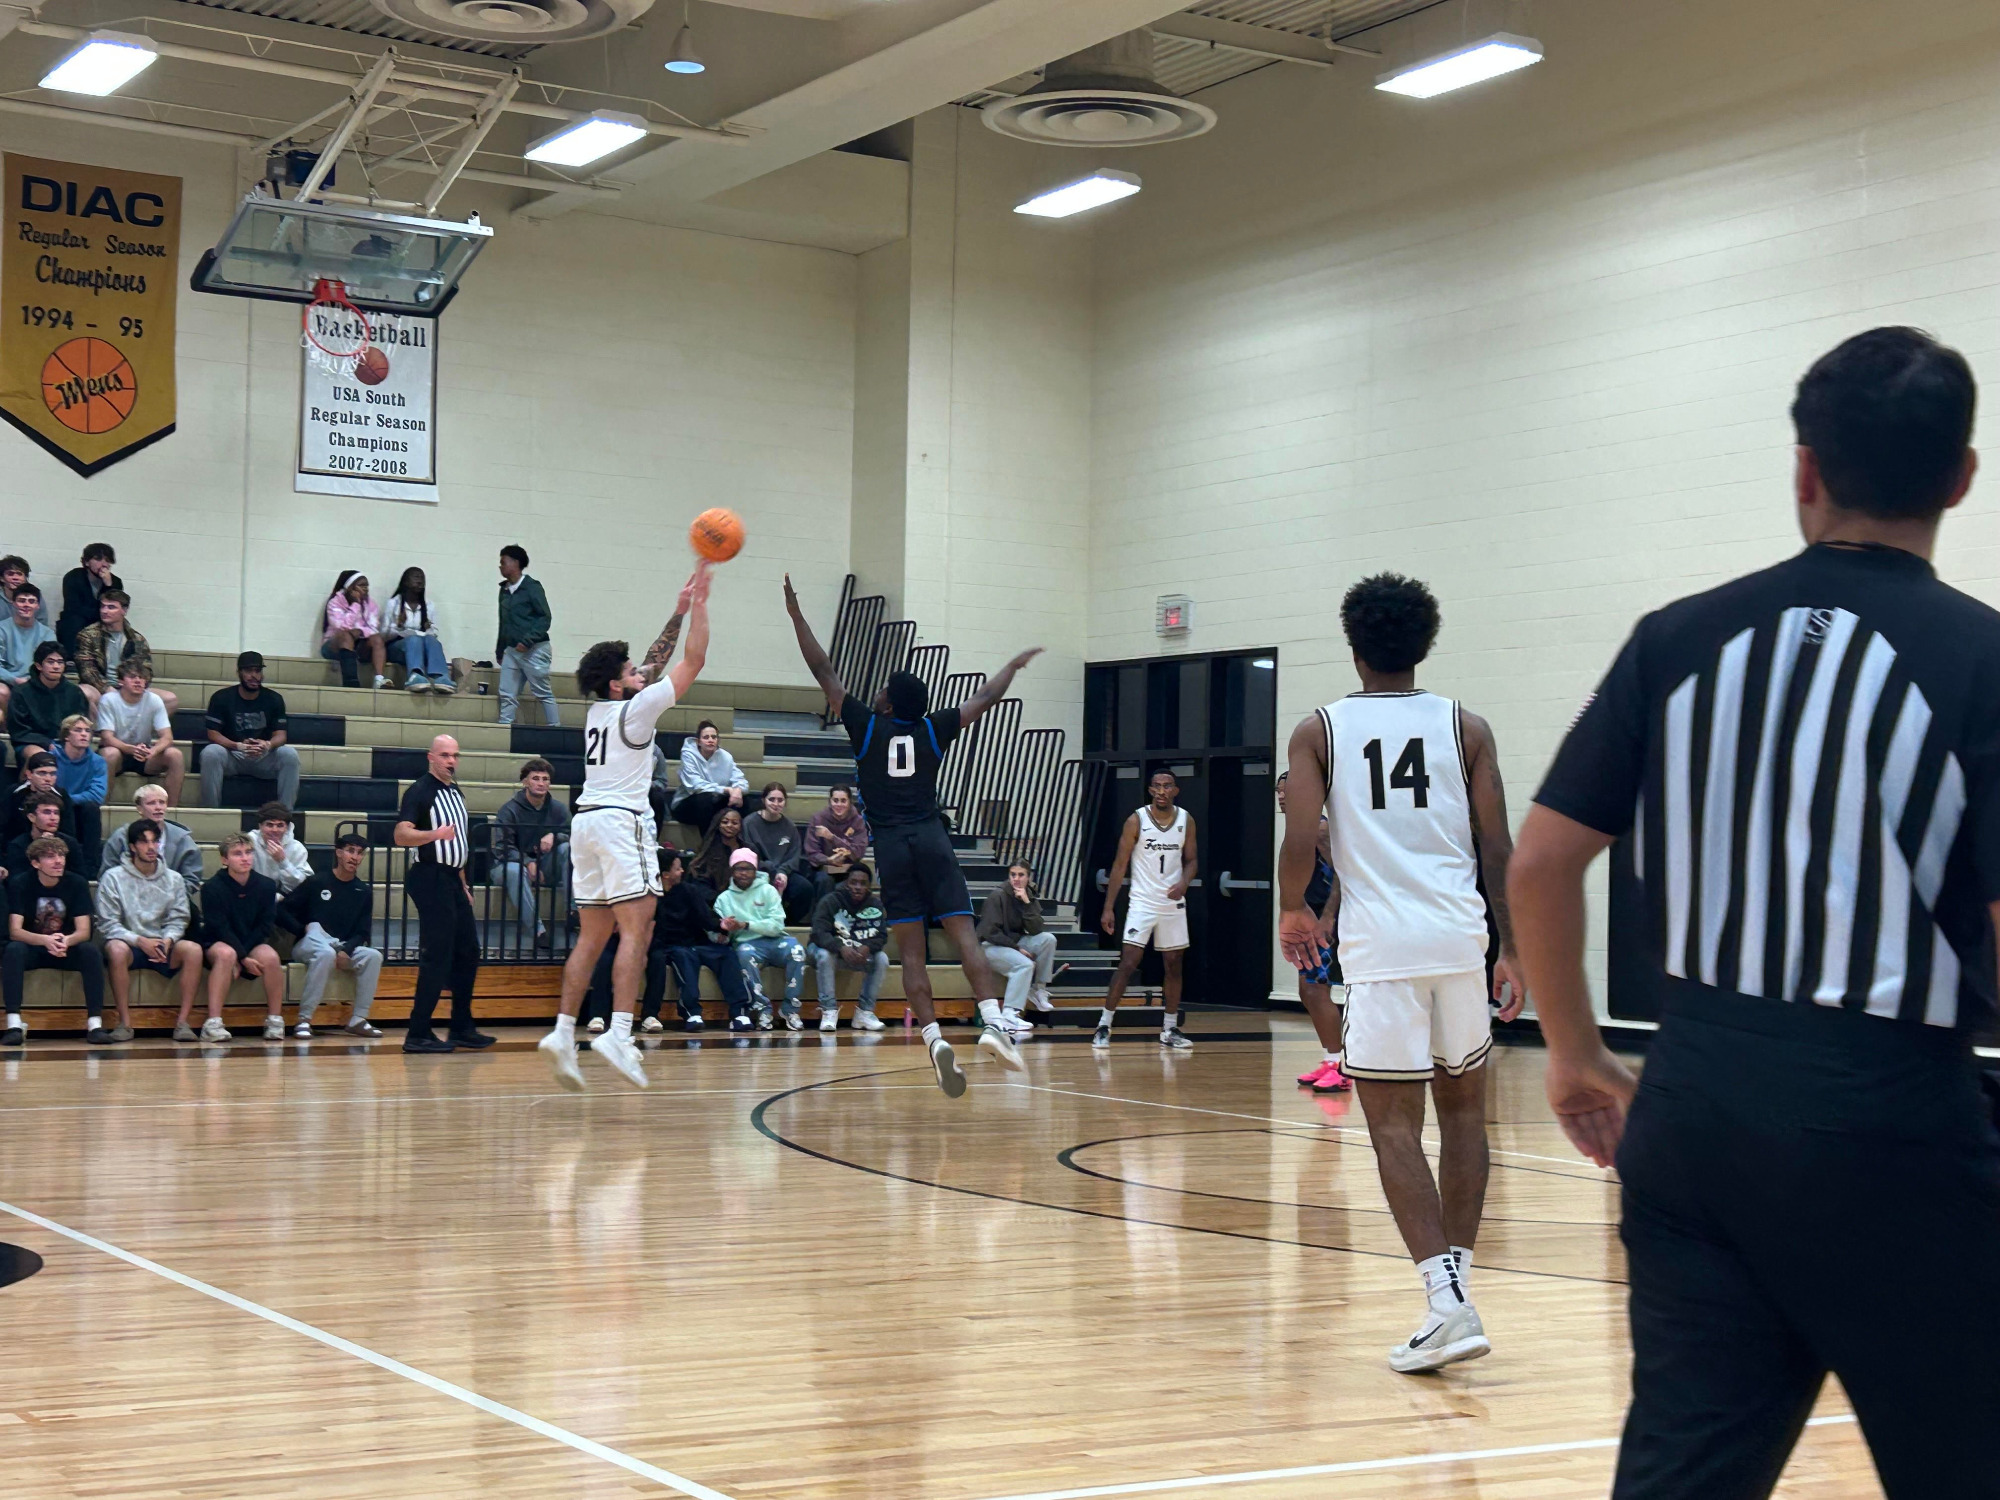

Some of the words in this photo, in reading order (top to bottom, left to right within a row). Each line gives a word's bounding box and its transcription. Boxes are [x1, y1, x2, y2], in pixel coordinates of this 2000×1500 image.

[22, 174, 164, 227] DIAC
[18, 221, 90, 249] Regular
[105, 234, 167, 257] Season
[35, 254, 147, 297] Champions
[21, 305, 74, 330] 1994
[119, 316, 143, 338] 95
[315, 314, 427, 348] Basketball
[55, 371, 124, 410] Mens
[332, 386, 361, 403] USA
[365, 390, 406, 407] South
[310, 406, 371, 427] Regular
[376, 413, 427, 432] Season
[328, 432, 408, 453] Champions
[328, 454, 408, 475] 2007-2008
[586, 726, 608, 766] 21
[887, 735, 916, 778] 0
[1363, 737, 1430, 810] 14
[1159, 854, 1165, 874] 1
